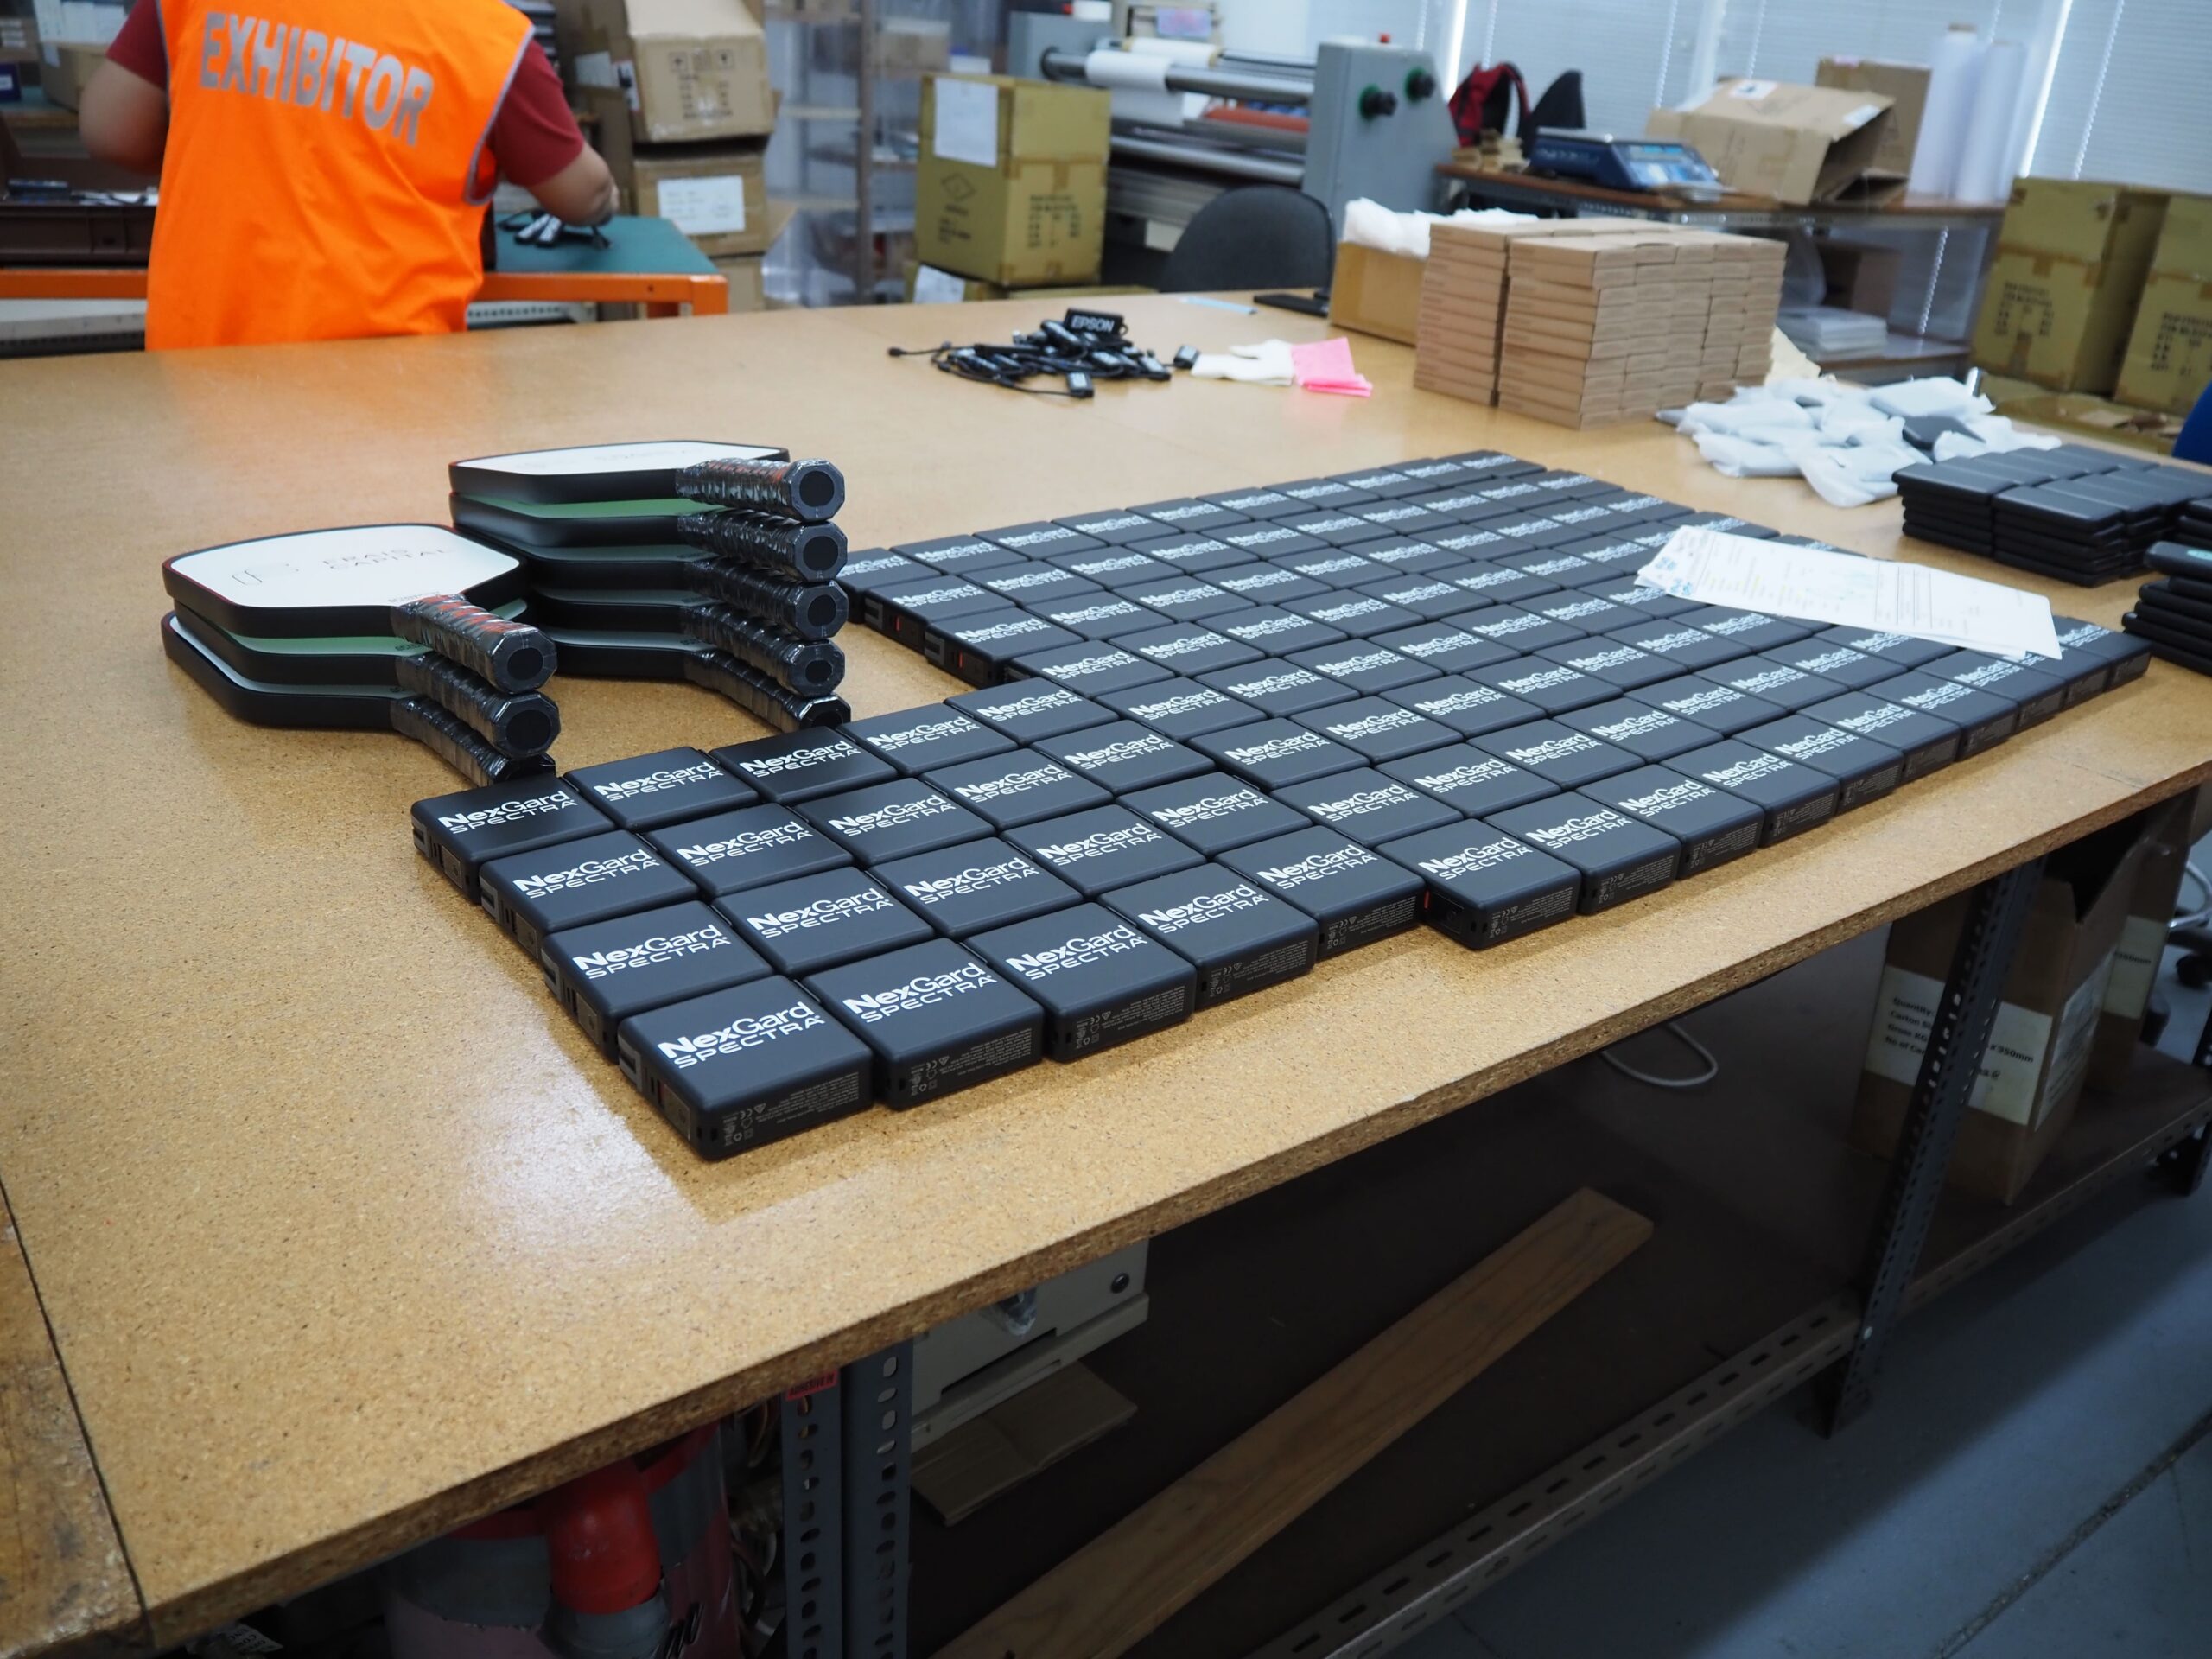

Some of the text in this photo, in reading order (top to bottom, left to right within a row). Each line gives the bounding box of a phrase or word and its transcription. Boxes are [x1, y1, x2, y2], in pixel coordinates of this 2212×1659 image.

[200, 11, 434, 147] EXHIBITOR
[1071, 315, 1115, 333] EPSON
[954, 617, 1043, 640] NexGard
[1050, 601, 1134, 622] NexGard
[1139, 632, 1223, 656] NexGard
[1315, 649, 1395, 673] NexGard
[1041, 651, 1131, 676] NexGard
[1227, 669, 1313, 695] NexGard
[1414, 686, 1497, 712] NexGard
[976, 689, 1073, 718] NexGard
[991, 696, 1083, 722] SPECTRA
[1128, 689, 1220, 716] NexGard
[866, 715, 972, 747] NexGard
[880, 723, 981, 752] SPECTRA
[1325, 708, 1415, 735] NexGard
[1590, 709, 1669, 737] NexGard
[739, 740, 854, 772] NexGard
[753, 747, 861, 778] SPECTRA
[1064, 734, 1165, 765] NexGard
[1079, 741, 1174, 770] SPECTRA
[1224, 731, 1320, 760] NexGard
[1504, 733, 1592, 760] NexGard
[593, 761, 716, 796] NexGard
[953, 764, 1064, 798] NexGard
[1414, 758, 1506, 788] NexGard
[1701, 753, 1781, 783] NexGard
[606, 770, 724, 802] SPECTRA
[969, 772, 1073, 804] SPECTRA
[1306, 783, 1408, 817] NexGard
[1618, 779, 1704, 811] NexGard
[438, 790, 570, 828] NexGard
[449, 799, 578, 835] SPECTRA
[828, 794, 947, 830] NexGard
[843, 803, 957, 836] SPECTRA
[1151, 788, 1258, 822] NexGard
[1168, 797, 1269, 828] SPECTRA
[676, 821, 804, 861] NexGard
[1035, 823, 1152, 860] NexGard
[1525, 809, 1620, 843] NexGard
[690, 830, 813, 867] SPECTRA
[1052, 832, 1162, 867] SPECTRA
[1256, 843, 1366, 883] NexGard
[1417, 836, 1521, 874] NexGard
[512, 849, 652, 892] NexGard
[525, 859, 661, 899] SPECTRA
[903, 856, 1030, 897] NexGard
[919, 867, 1040, 905] SPECTRA
[1276, 854, 1378, 890] SPECTRA
[746, 887, 885, 931] NexGard
[760, 899, 894, 938] SPECTRA
[1137, 883, 1258, 926] NexGard
[1157, 894, 1269, 934] SPECTRA
[572, 924, 723, 971] NexGard
[585, 936, 732, 980] SPECTRA
[1005, 924, 1136, 972] NexGard
[1025, 936, 1148, 981] SPECTRA
[842, 962, 986, 1014] NexGard
[861, 974, 998, 1023] SPECTRA
[657, 1001, 815, 1059] NexGard
[1891, 1010, 1920, 1026] Carton
[673, 1014, 825, 1069] SPECTRA
